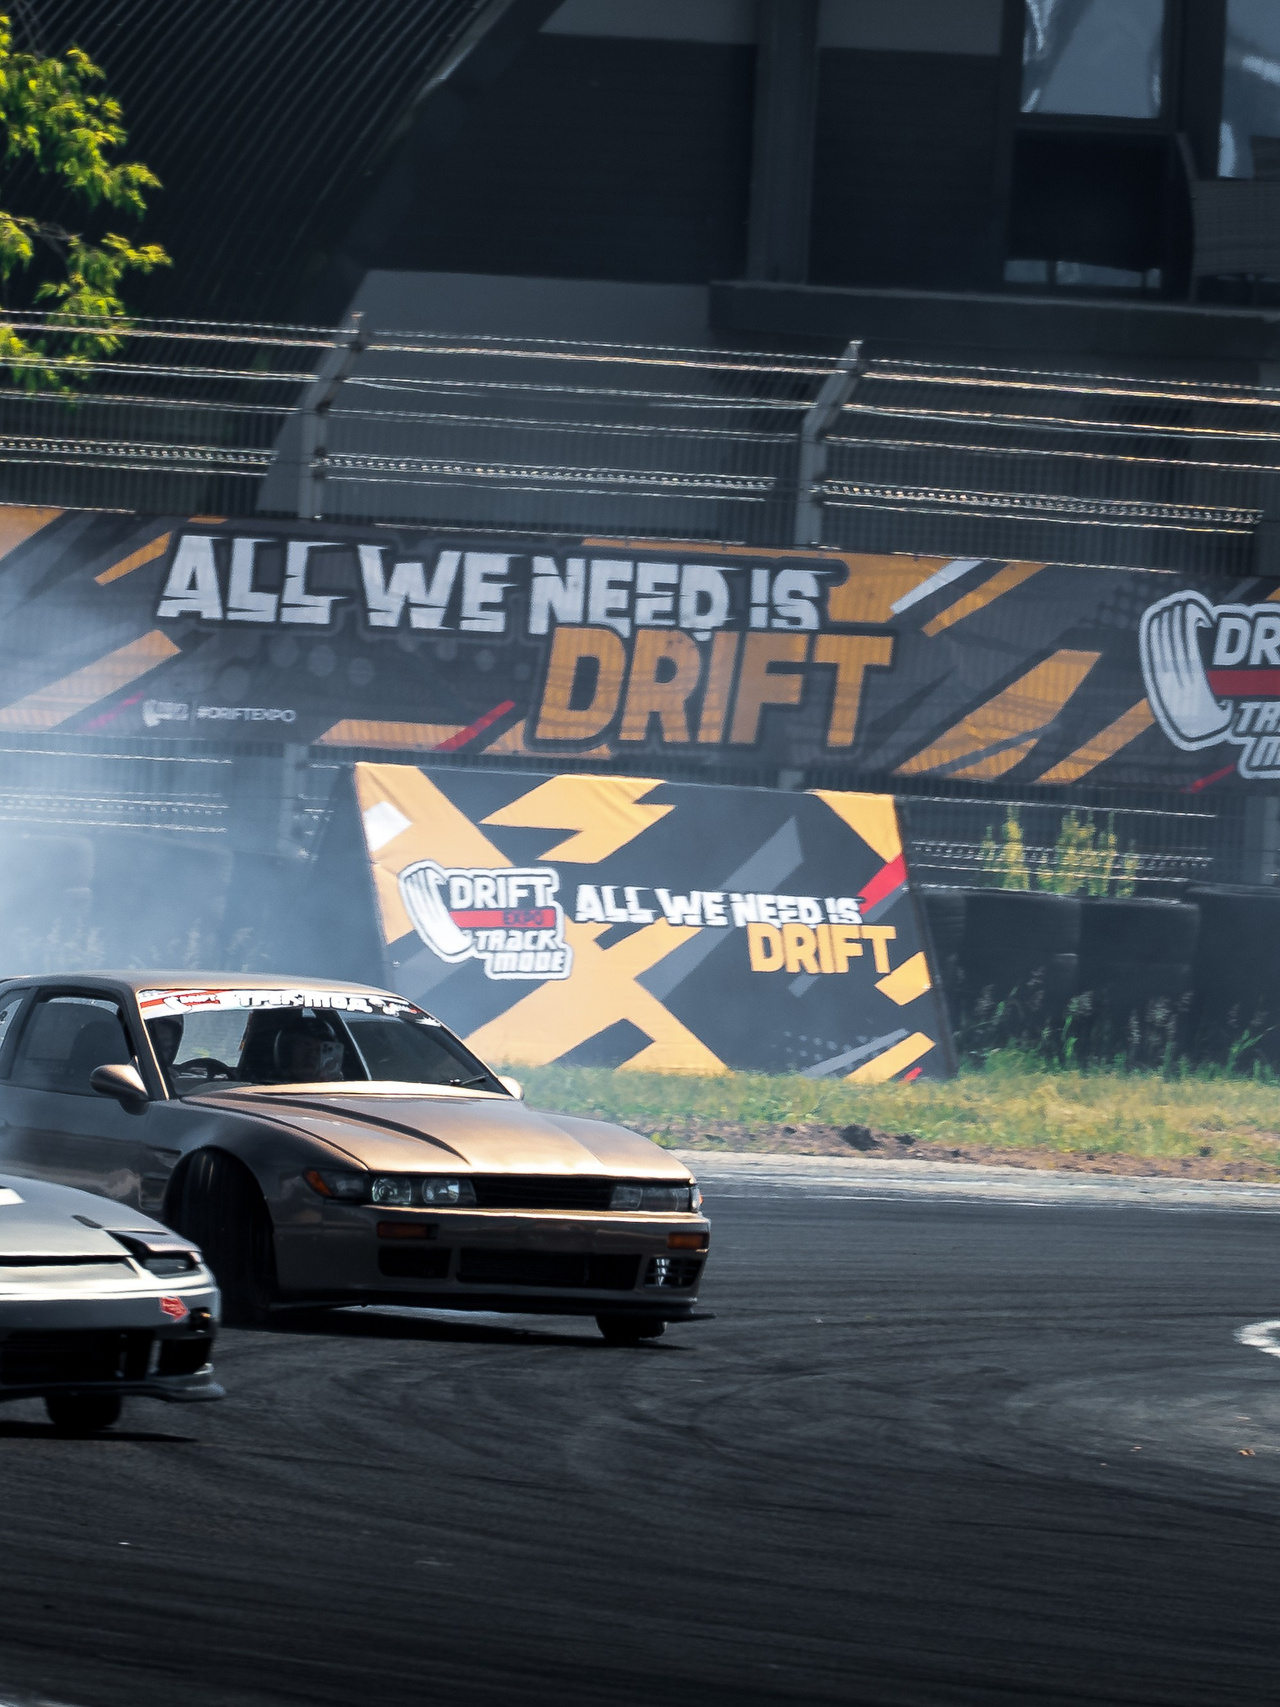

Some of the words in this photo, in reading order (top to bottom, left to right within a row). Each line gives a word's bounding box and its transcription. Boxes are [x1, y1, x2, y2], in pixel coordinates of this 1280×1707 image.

[156, 534, 348, 625] ALL
[357, 544, 526, 633] WE
[528, 556, 743, 641] NEED
[749, 568, 833, 630] IS
[535, 627, 895, 748] DRIFT
[449, 876, 552, 909] DRIFT
[575, 884, 656, 923] ALL
[654, 888, 728, 926] WE
[729, 893, 825, 928] NEED
[824, 897, 864, 925] IS
[491, 950, 565, 973] MODE
[747, 922, 896, 974] DRIFT
